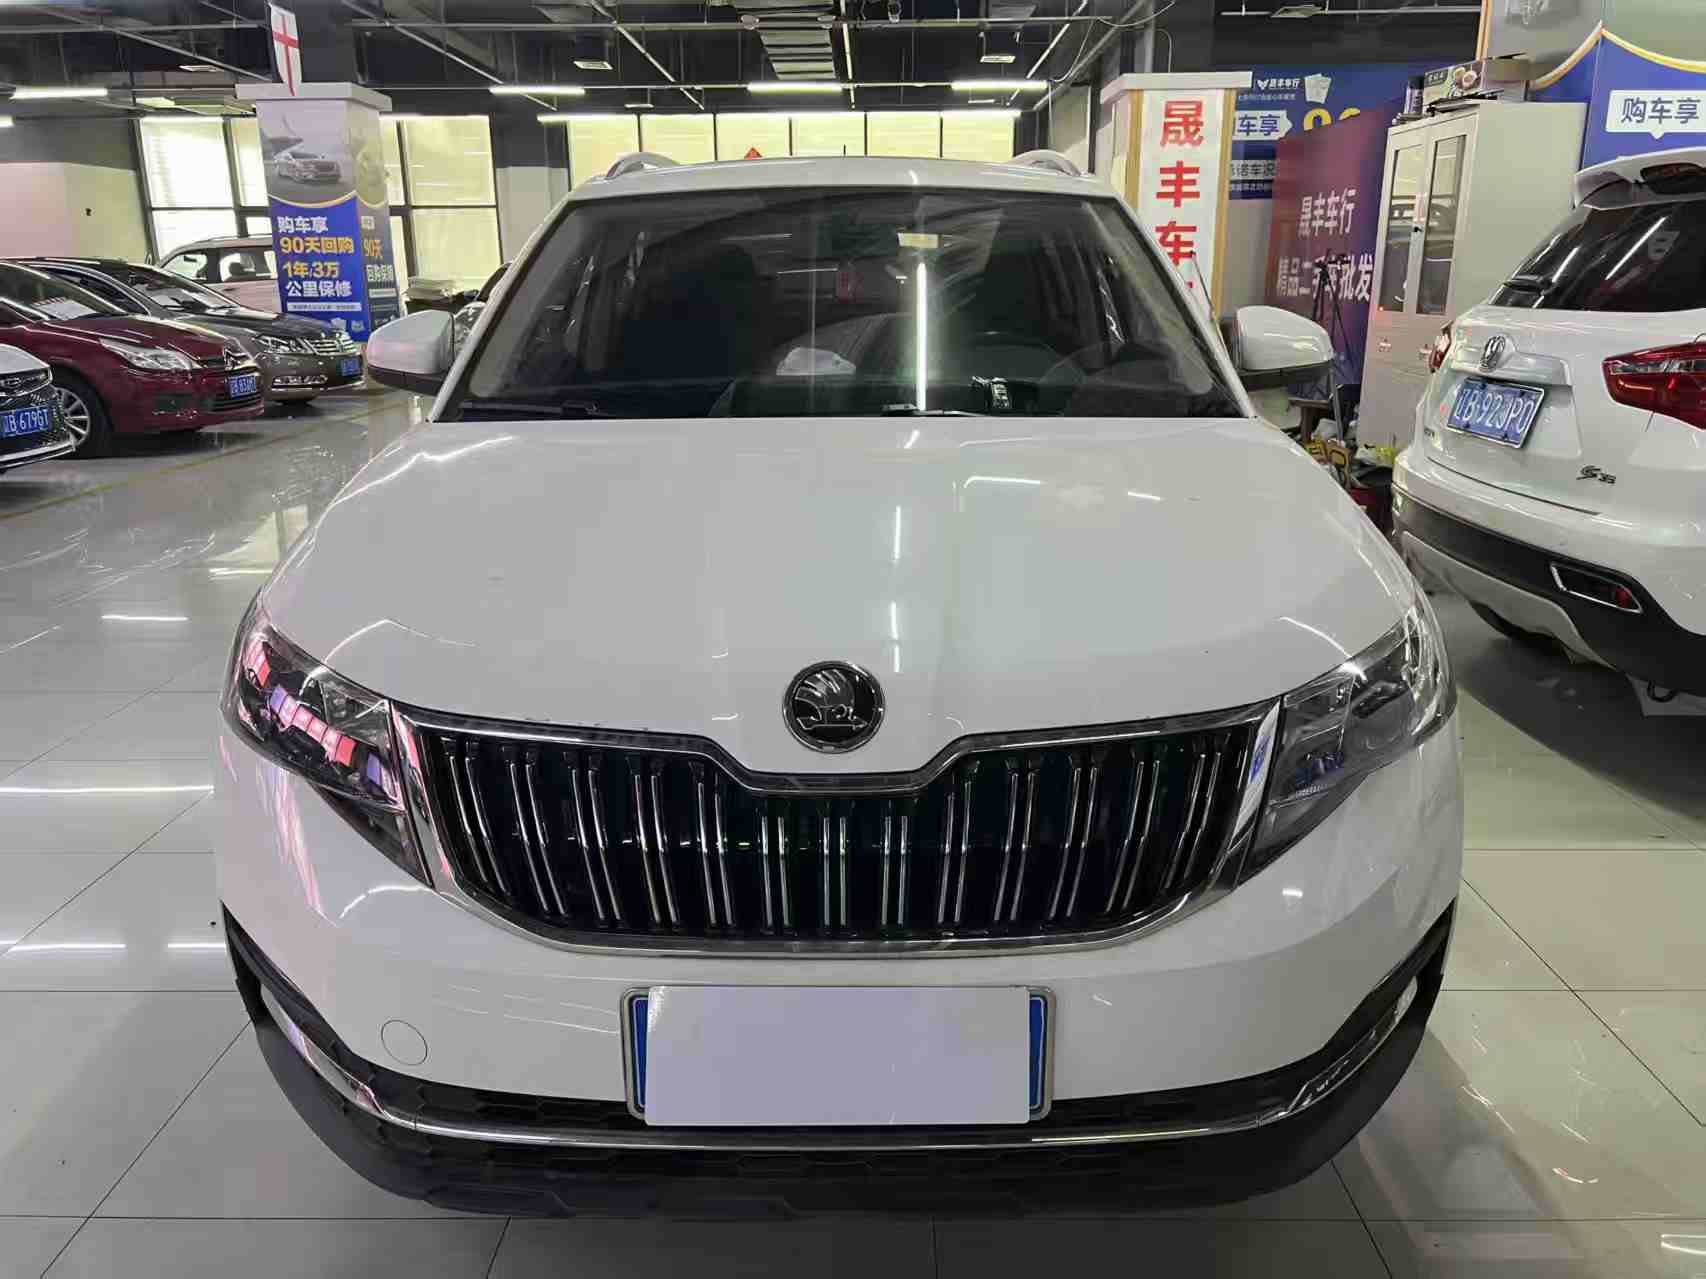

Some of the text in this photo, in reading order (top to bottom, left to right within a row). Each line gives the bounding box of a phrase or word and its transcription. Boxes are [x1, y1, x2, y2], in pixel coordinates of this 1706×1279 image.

[1620, 96, 1701, 125] 购车享
[1233, 113, 1281, 137] 车享
[1154, 100, 1204, 288] 晟丰车
[277, 215, 329, 234] 购车享
[280, 236, 355, 255] 90天回购
[285, 280, 353, 298] 公里保修
